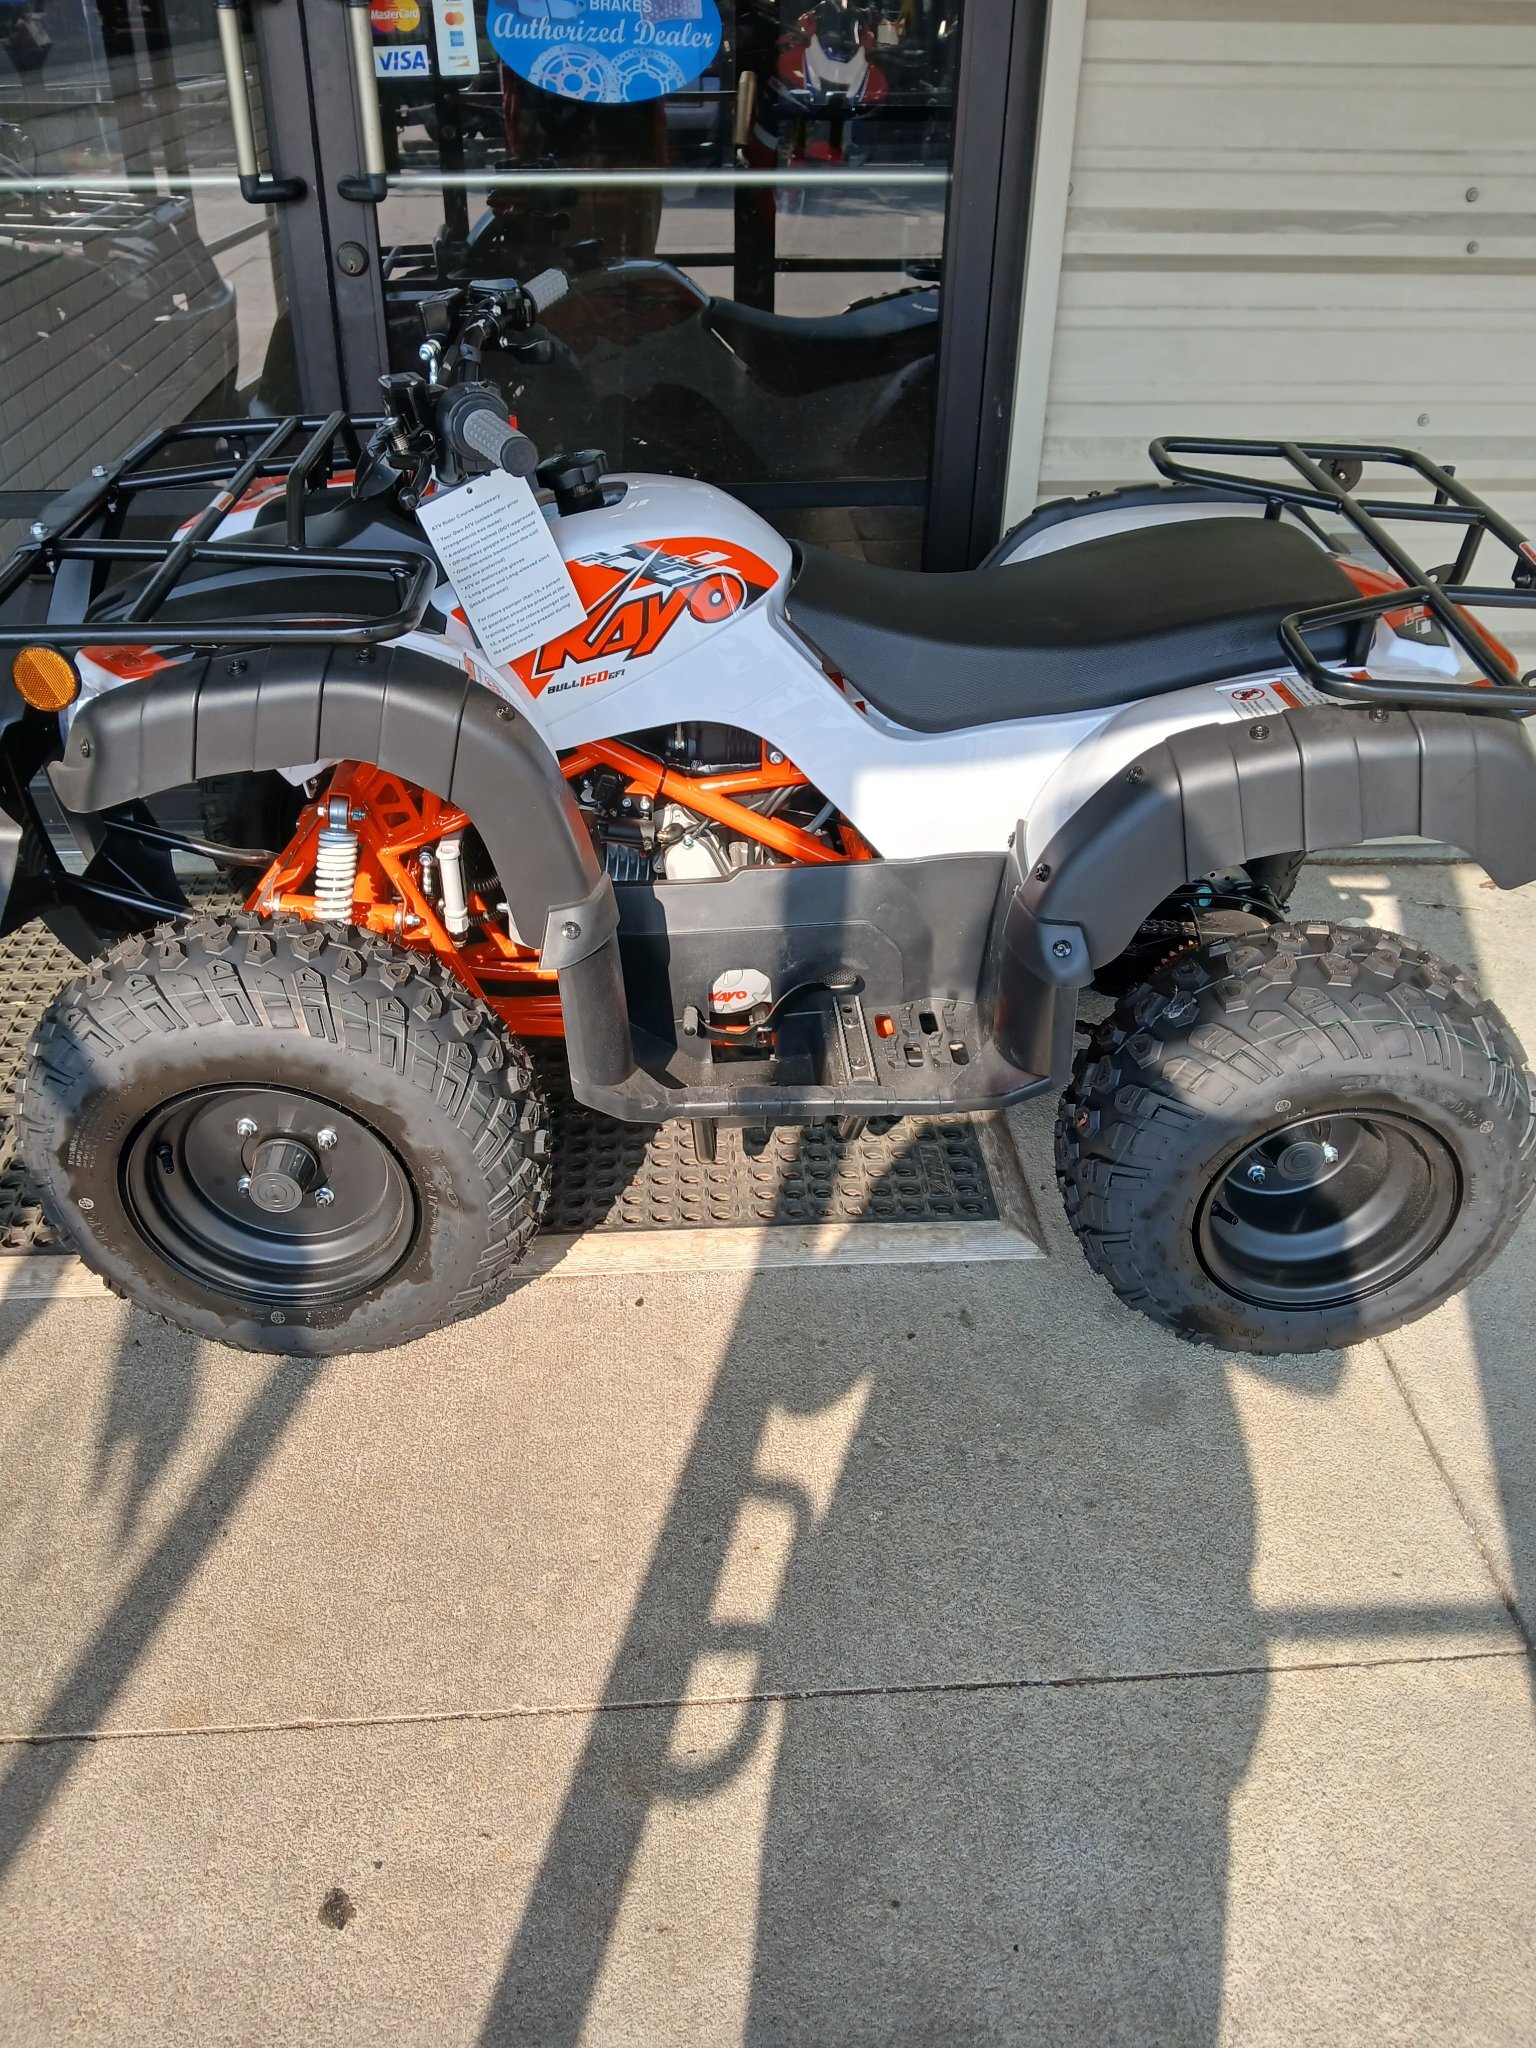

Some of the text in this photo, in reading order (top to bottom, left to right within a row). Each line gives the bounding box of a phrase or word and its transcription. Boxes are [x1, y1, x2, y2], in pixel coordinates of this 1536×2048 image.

[589, 0, 653, 13] BRAKES
[371, 9, 419, 19] MasterCard
[494, 12, 713, 48] Authorized Dealer
[379, 50, 427, 70] VISA
[452, 526, 464, 535] Own
[463, 521, 474, 529] ATV
[463, 582, 474, 590] ATV
[535, 558, 748, 675] KAYO
[708, 990, 748, 1002] KAYO
